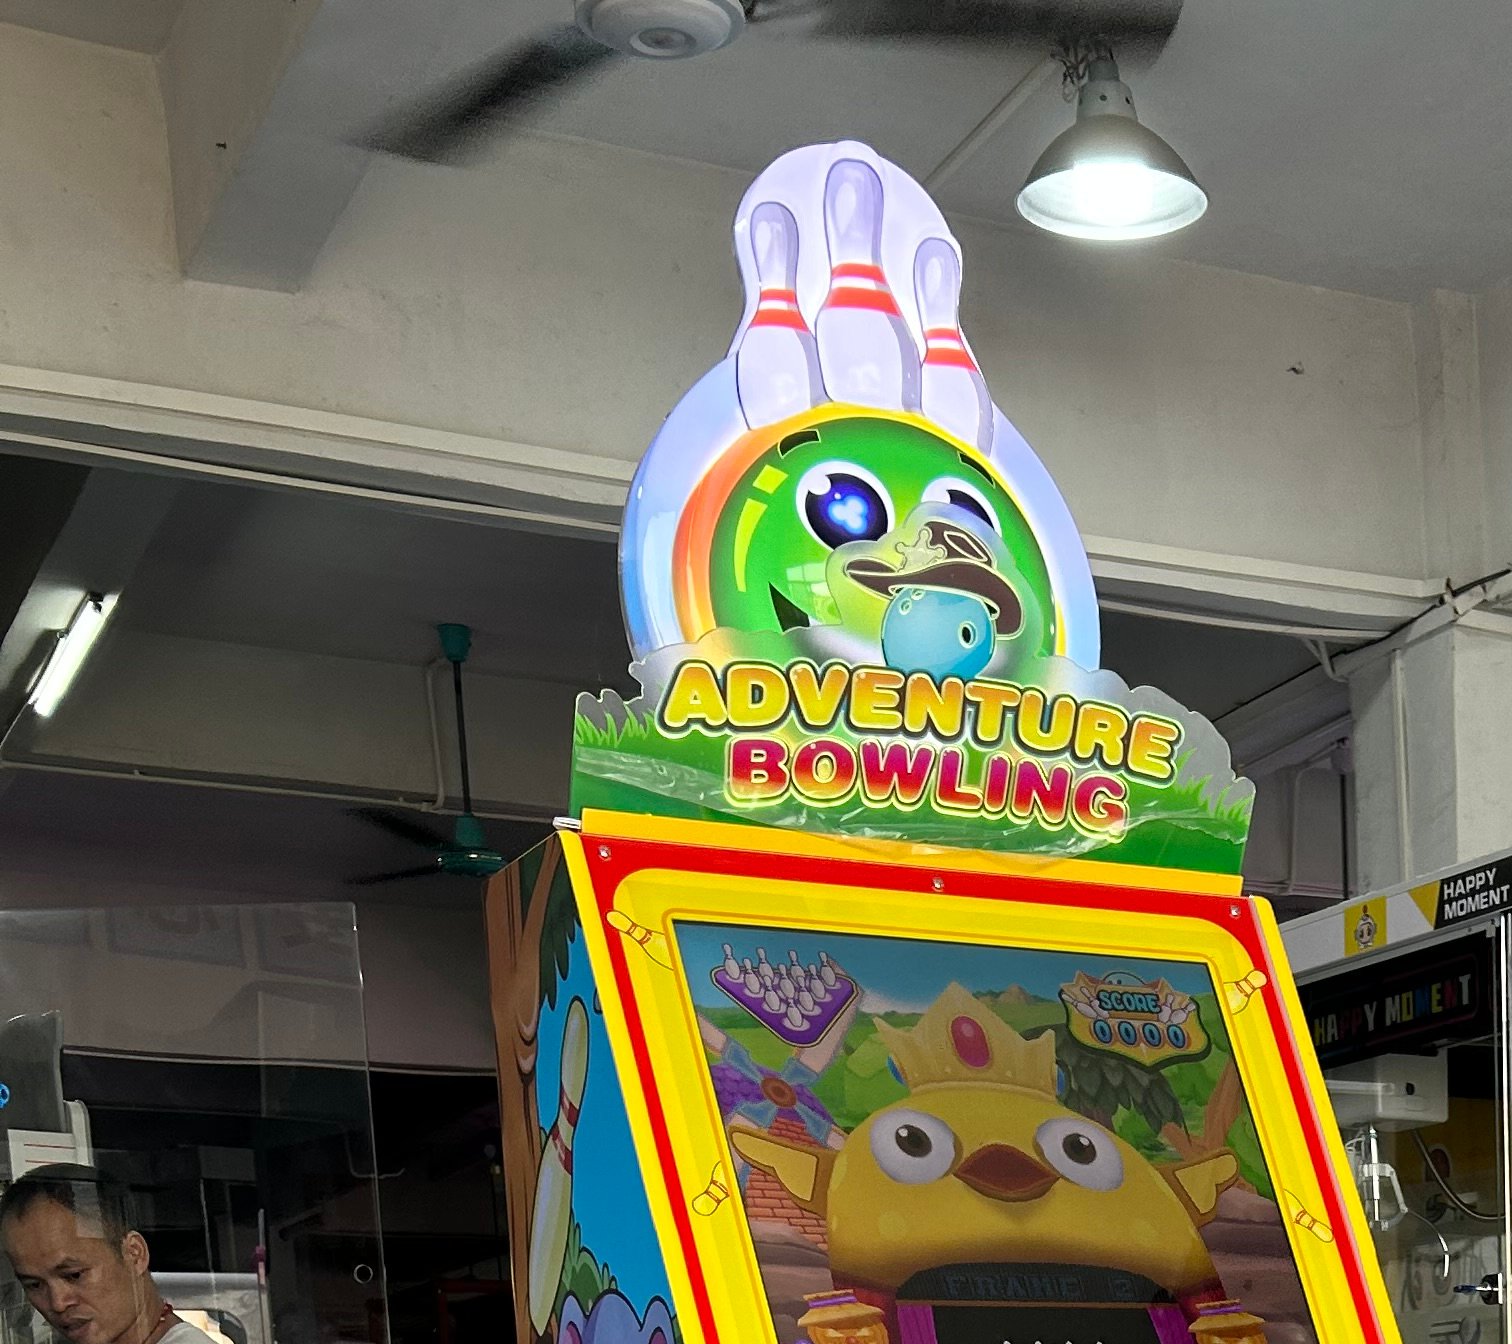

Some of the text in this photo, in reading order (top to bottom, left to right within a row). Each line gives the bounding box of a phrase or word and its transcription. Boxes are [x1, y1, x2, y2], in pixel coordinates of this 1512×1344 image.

[660, 661, 1182, 782] ADVENTURE
[725, 737, 1130, 840] BOWLING
[1443, 867, 1497, 898] HAPPY
[1443, 884, 1511, 920] MOMENT
[1099, 990, 1161, 1014] SCORE
[1314, 974, 1472, 1046] HAPPY MOMENT
